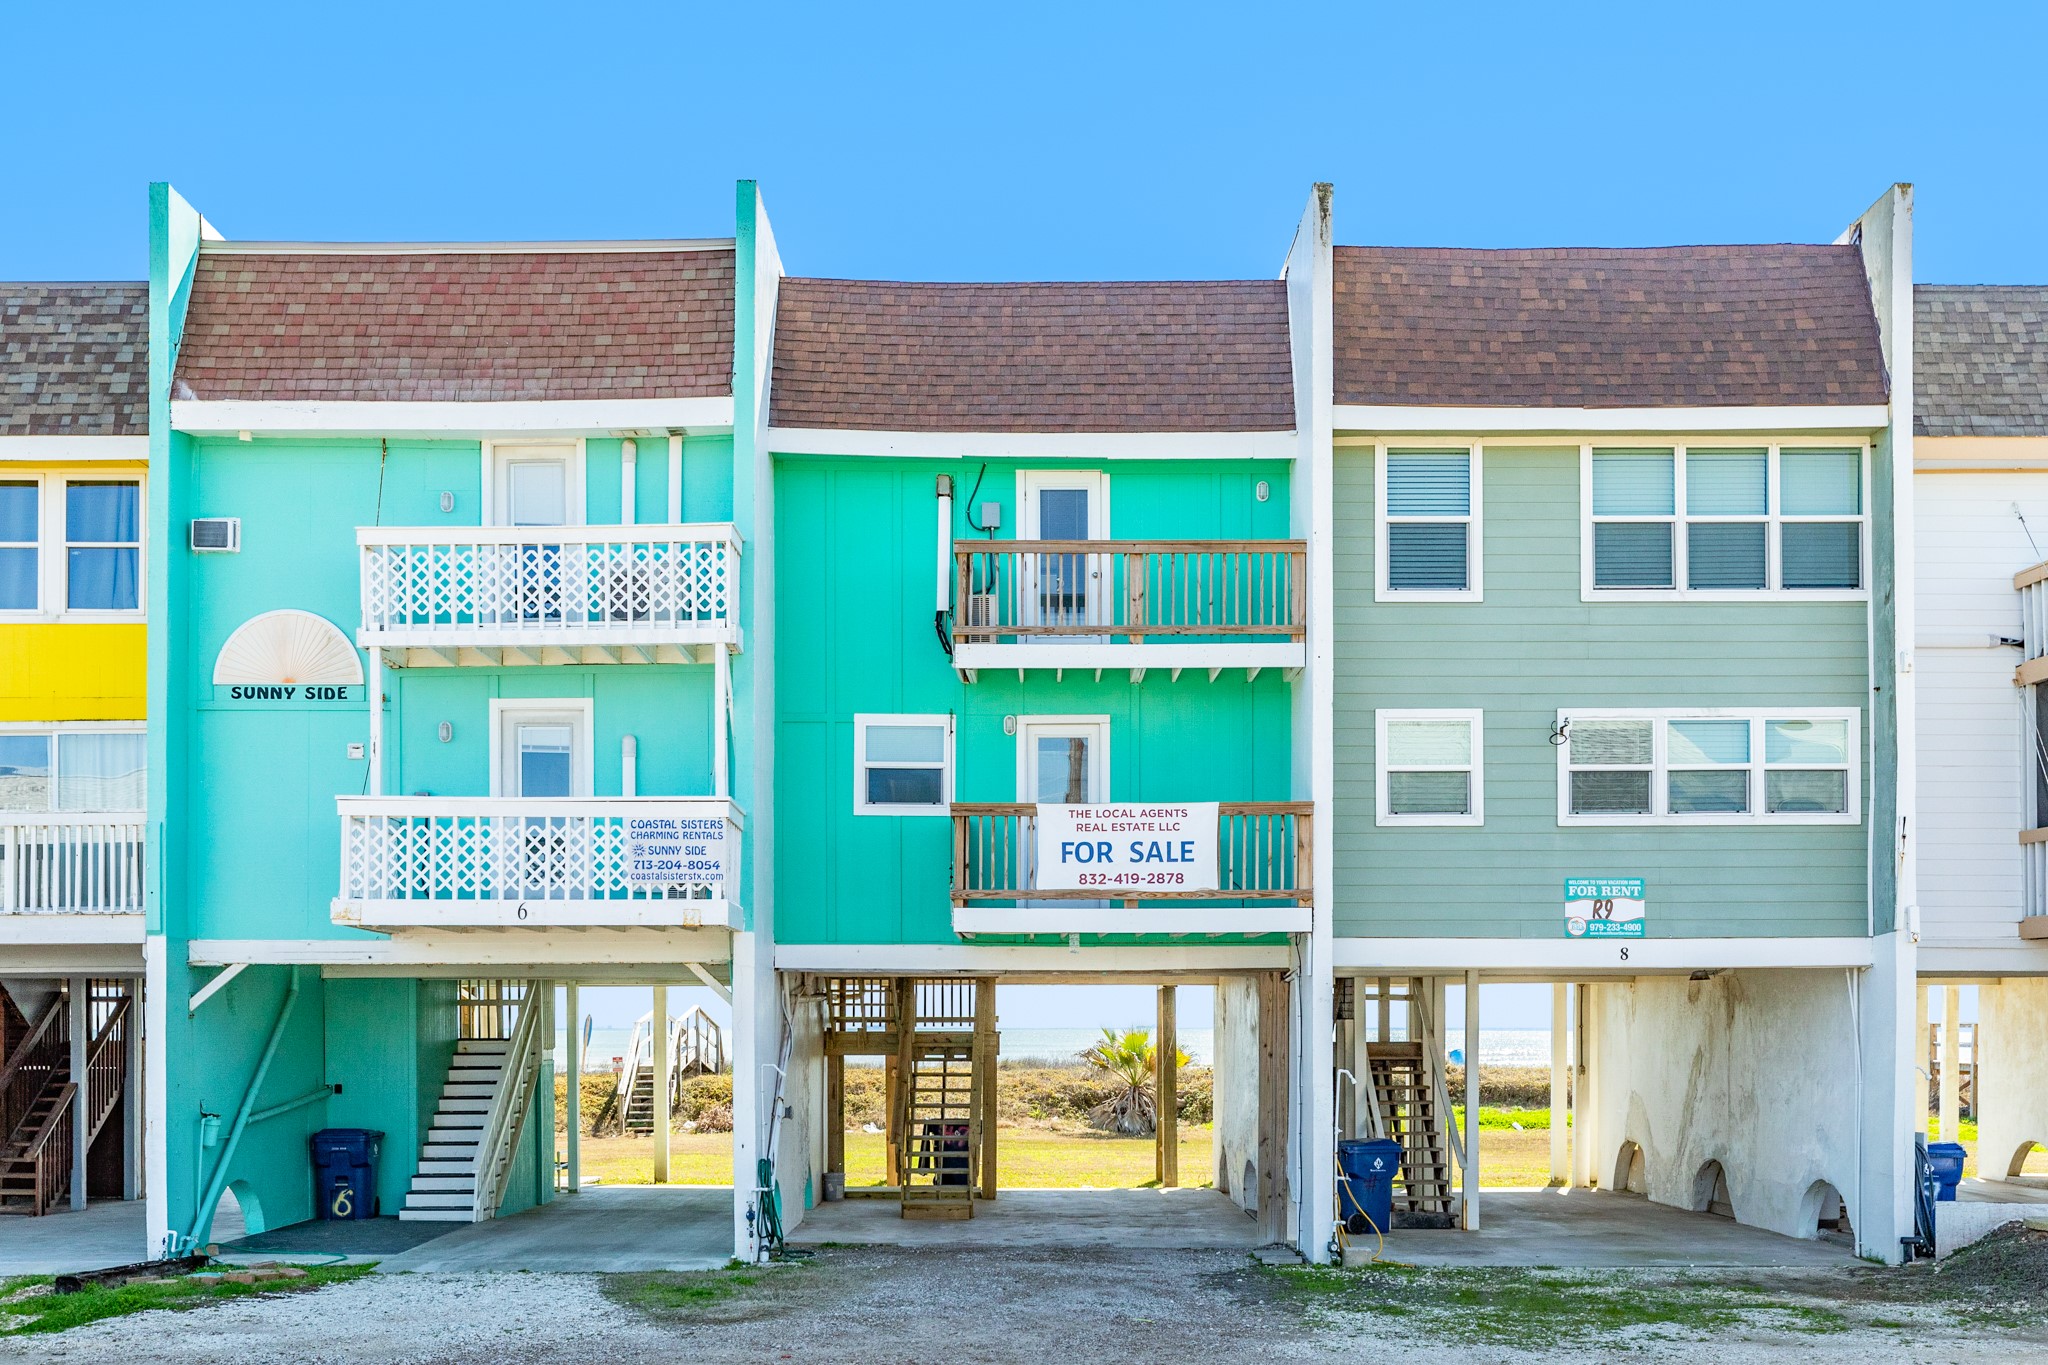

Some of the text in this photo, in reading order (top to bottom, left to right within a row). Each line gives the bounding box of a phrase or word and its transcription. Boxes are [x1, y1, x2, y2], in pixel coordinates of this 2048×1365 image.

[230, 686, 348, 700] SUNNY SIDE
[1068, 808, 1188, 819] THE LOCAL AGENTS
[630, 819, 724, 829] COASTAL SISTERS
[1076, 822, 1181, 832] REAL ESTATE LLC
[630, 831, 724, 840] CHARMING RENTALS
[648, 845, 707, 856] SUNNY SIDE
[1061, 840, 1195, 864] FOR SALE
[633, 860, 721, 870] 713-204-8054
[630, 871, 724, 881] coastalsisterstx.com
[1078, 872, 1185, 885] 832-419-2878
[1568, 885, 1642, 897] FOR RENT
[517, 901, 528, 921] 6
[1592, 898, 1614, 920] R9
[1589, 923, 1642, 932] 979-233-4900
[1620, 946, 1629, 961] 8
[333, 1188, 354, 1217] 6
